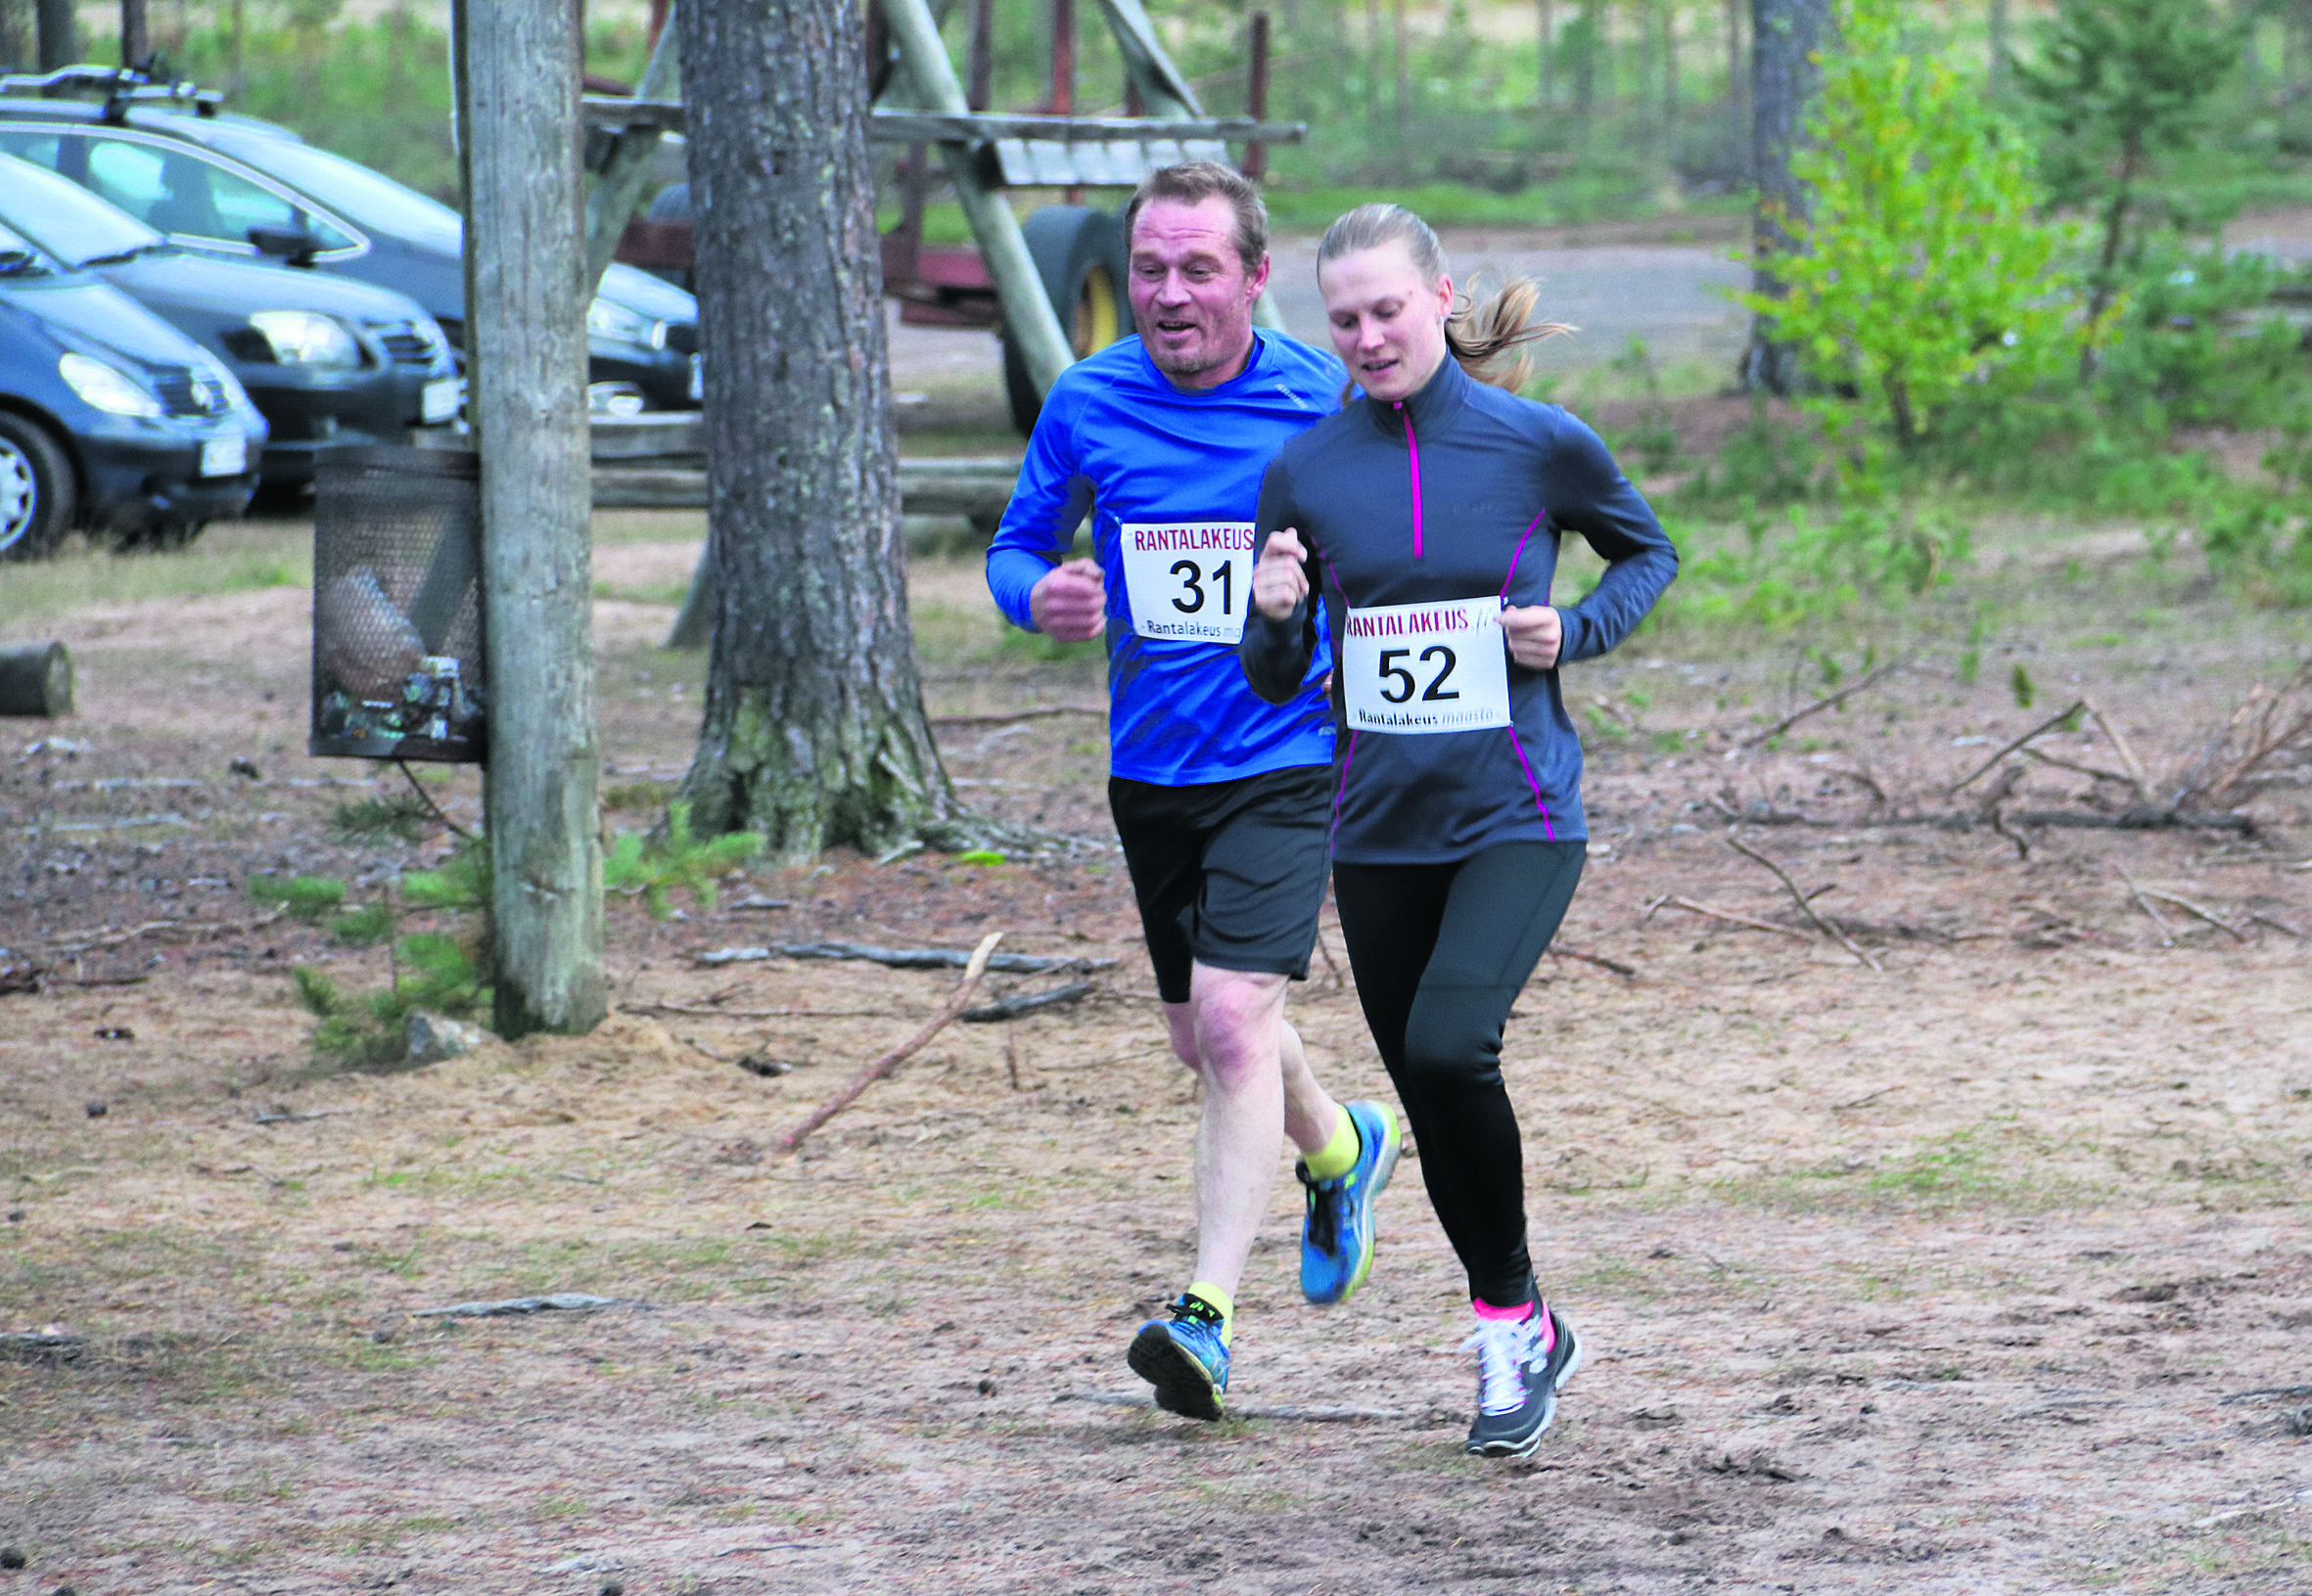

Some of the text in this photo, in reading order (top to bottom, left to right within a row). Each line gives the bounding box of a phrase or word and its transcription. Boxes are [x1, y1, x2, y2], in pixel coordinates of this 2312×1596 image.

[1170, 560, 1231, 615] 31
[1147, 619, 1222, 637] Rantalakeus
[1378, 645, 1460, 704] 52
[1360, 708, 1437, 725] Rantalakeus
